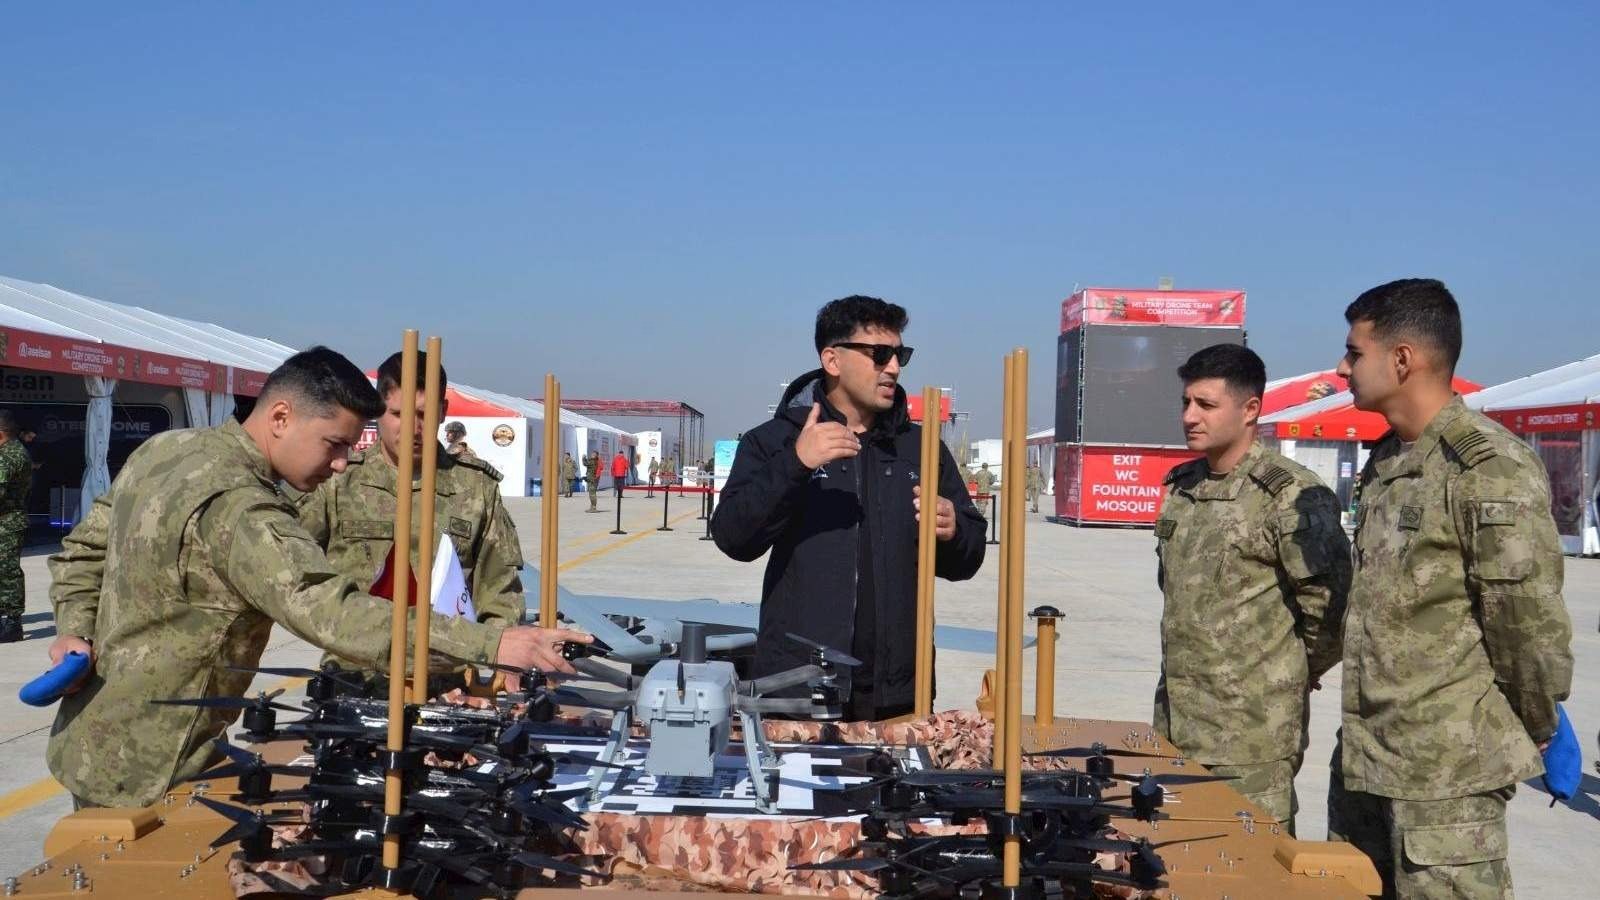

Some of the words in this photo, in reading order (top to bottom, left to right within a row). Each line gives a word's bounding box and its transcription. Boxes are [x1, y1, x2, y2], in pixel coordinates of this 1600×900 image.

[1132, 301, 1164, 309] MILITARY
[62, 348, 84, 361] MILITARY
[84, 352, 101, 363] DRONE
[100, 355, 113, 365] TEAM
[71, 362, 104, 373] COMPETITION
[1563, 413, 1579, 423] TENT
[1113, 454, 1143, 466] EXIT
[1115, 470, 1139, 481] WC
[1092, 484, 1161, 497] FOUNTAIN
[1096, 500, 1156, 513] MOSQUE
